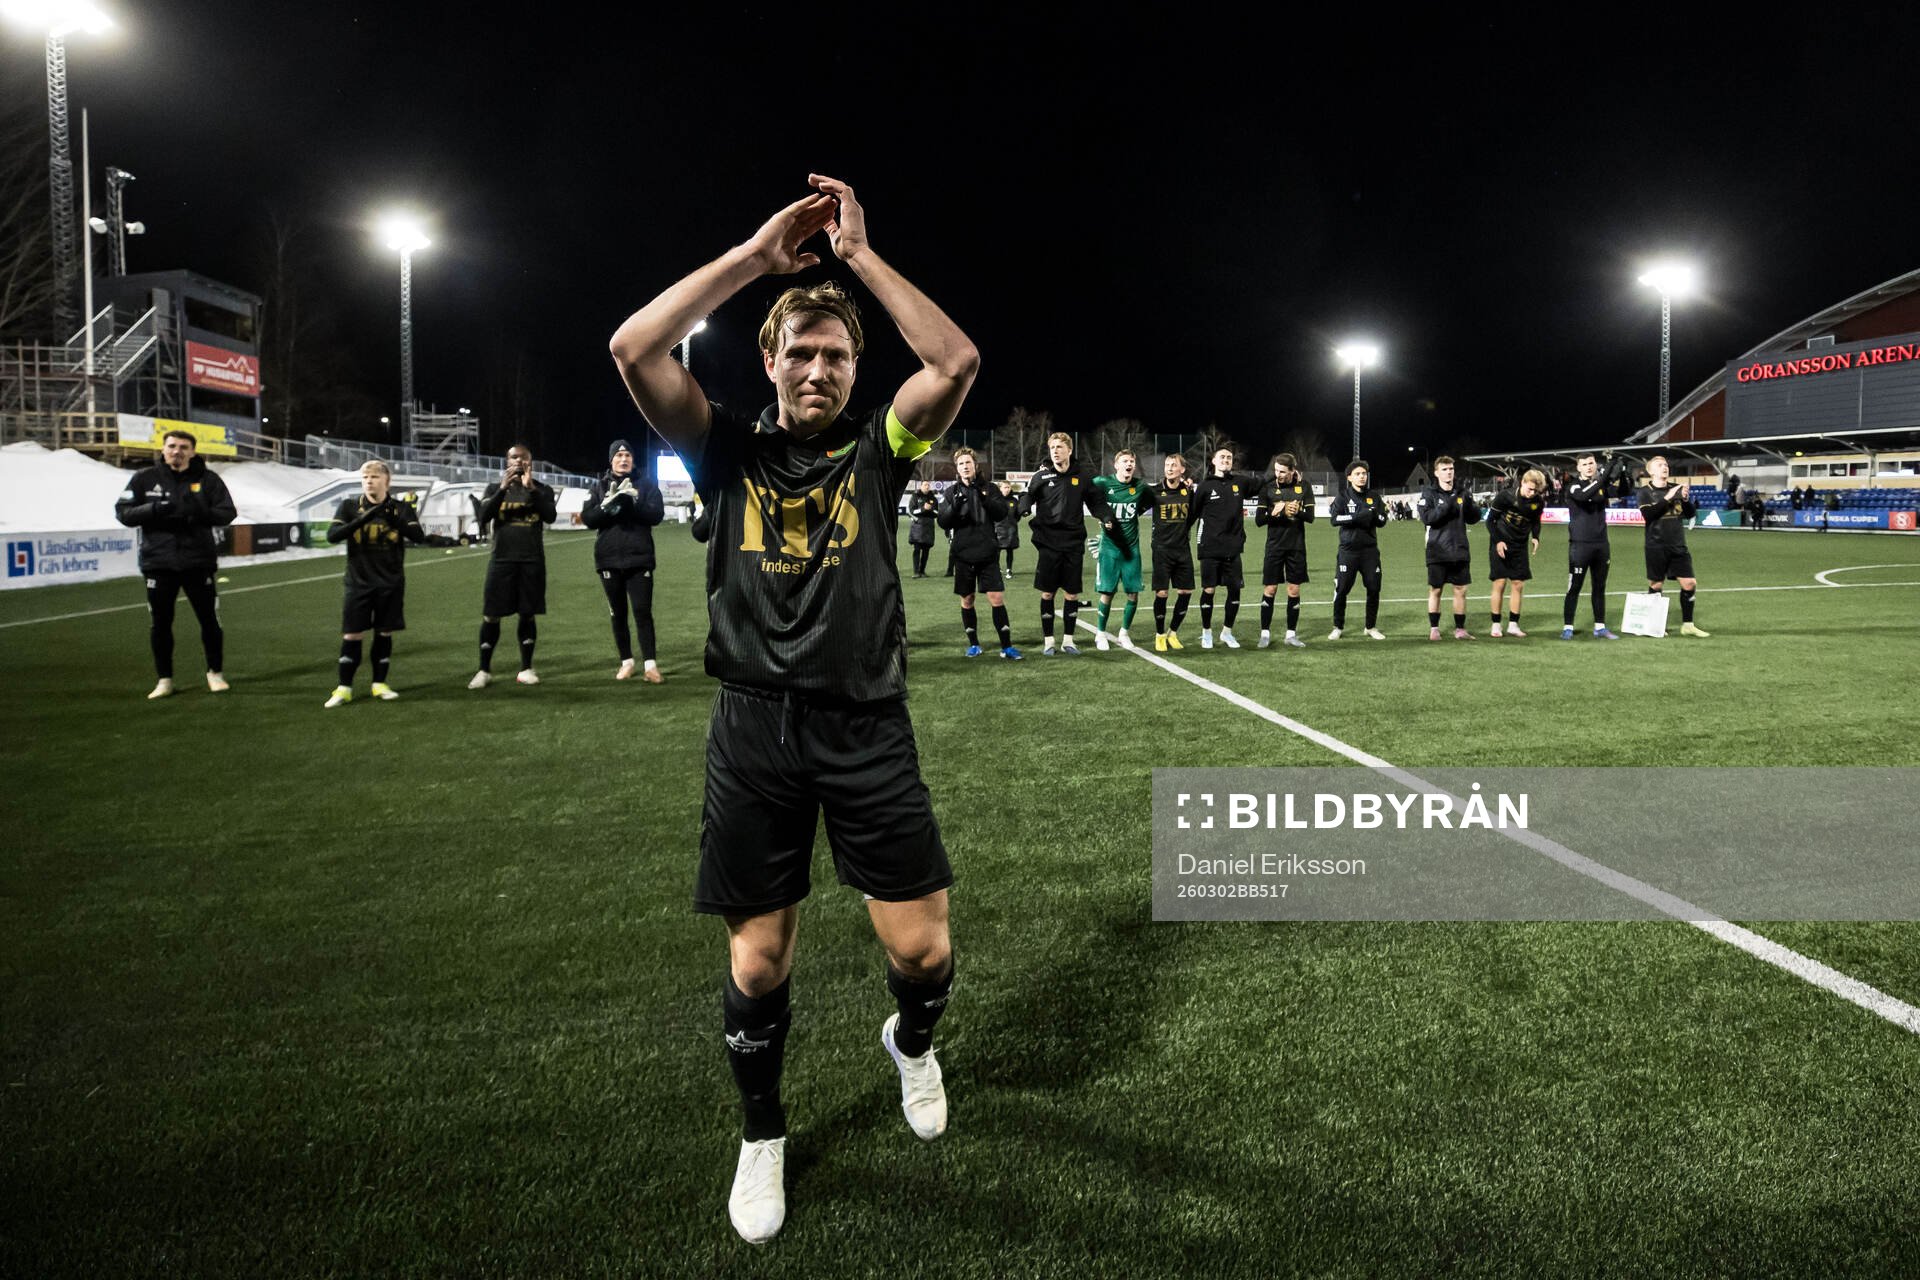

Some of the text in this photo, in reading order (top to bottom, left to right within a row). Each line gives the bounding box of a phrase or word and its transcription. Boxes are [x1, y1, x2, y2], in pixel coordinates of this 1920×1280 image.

[1737, 353, 1850, 382] GÖRANSSON
[1107, 502, 1136, 518] TS
[38, 557, 98, 575] Gävleborg
